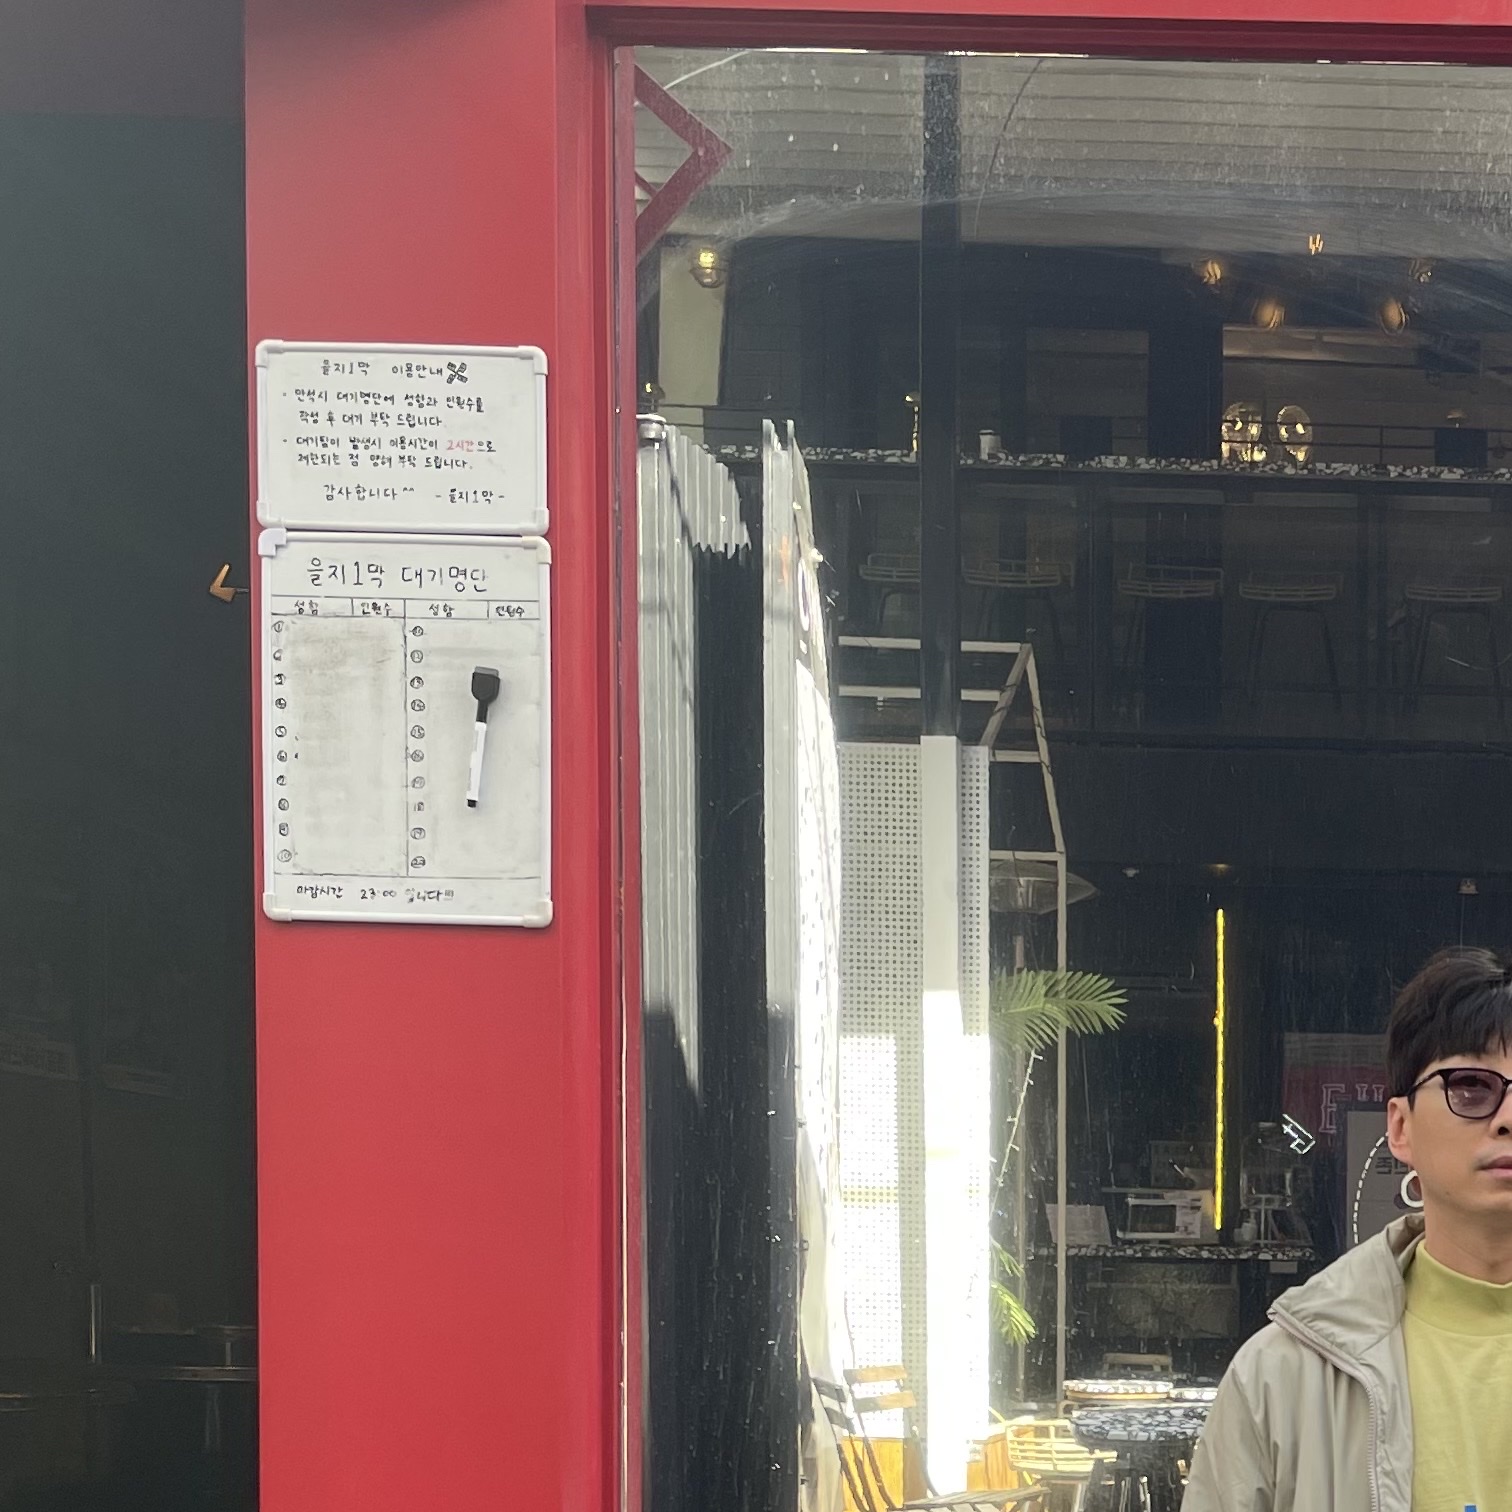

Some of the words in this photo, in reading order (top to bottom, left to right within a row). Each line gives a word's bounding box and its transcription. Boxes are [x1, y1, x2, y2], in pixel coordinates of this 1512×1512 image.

[392, 363, 443, 378] 이용안내
[337, 391, 394, 405] 대기명단에
[299, 410, 319, 424] 작성
[326, 410, 336, 427] 후
[342, 413, 363, 426] 대기
[370, 412, 390, 427] 부탁
[390, 436, 437, 450] 이용시간이
[348, 453, 359, 467] 점
[398, 455, 416, 468] 부탁
[324, 484, 398, 501] 감사합니다
[307, 557, 385, 588] 을지1막
[402, 566, 488, 592] 대기명단
[361, 602, 392, 616] 인원수
